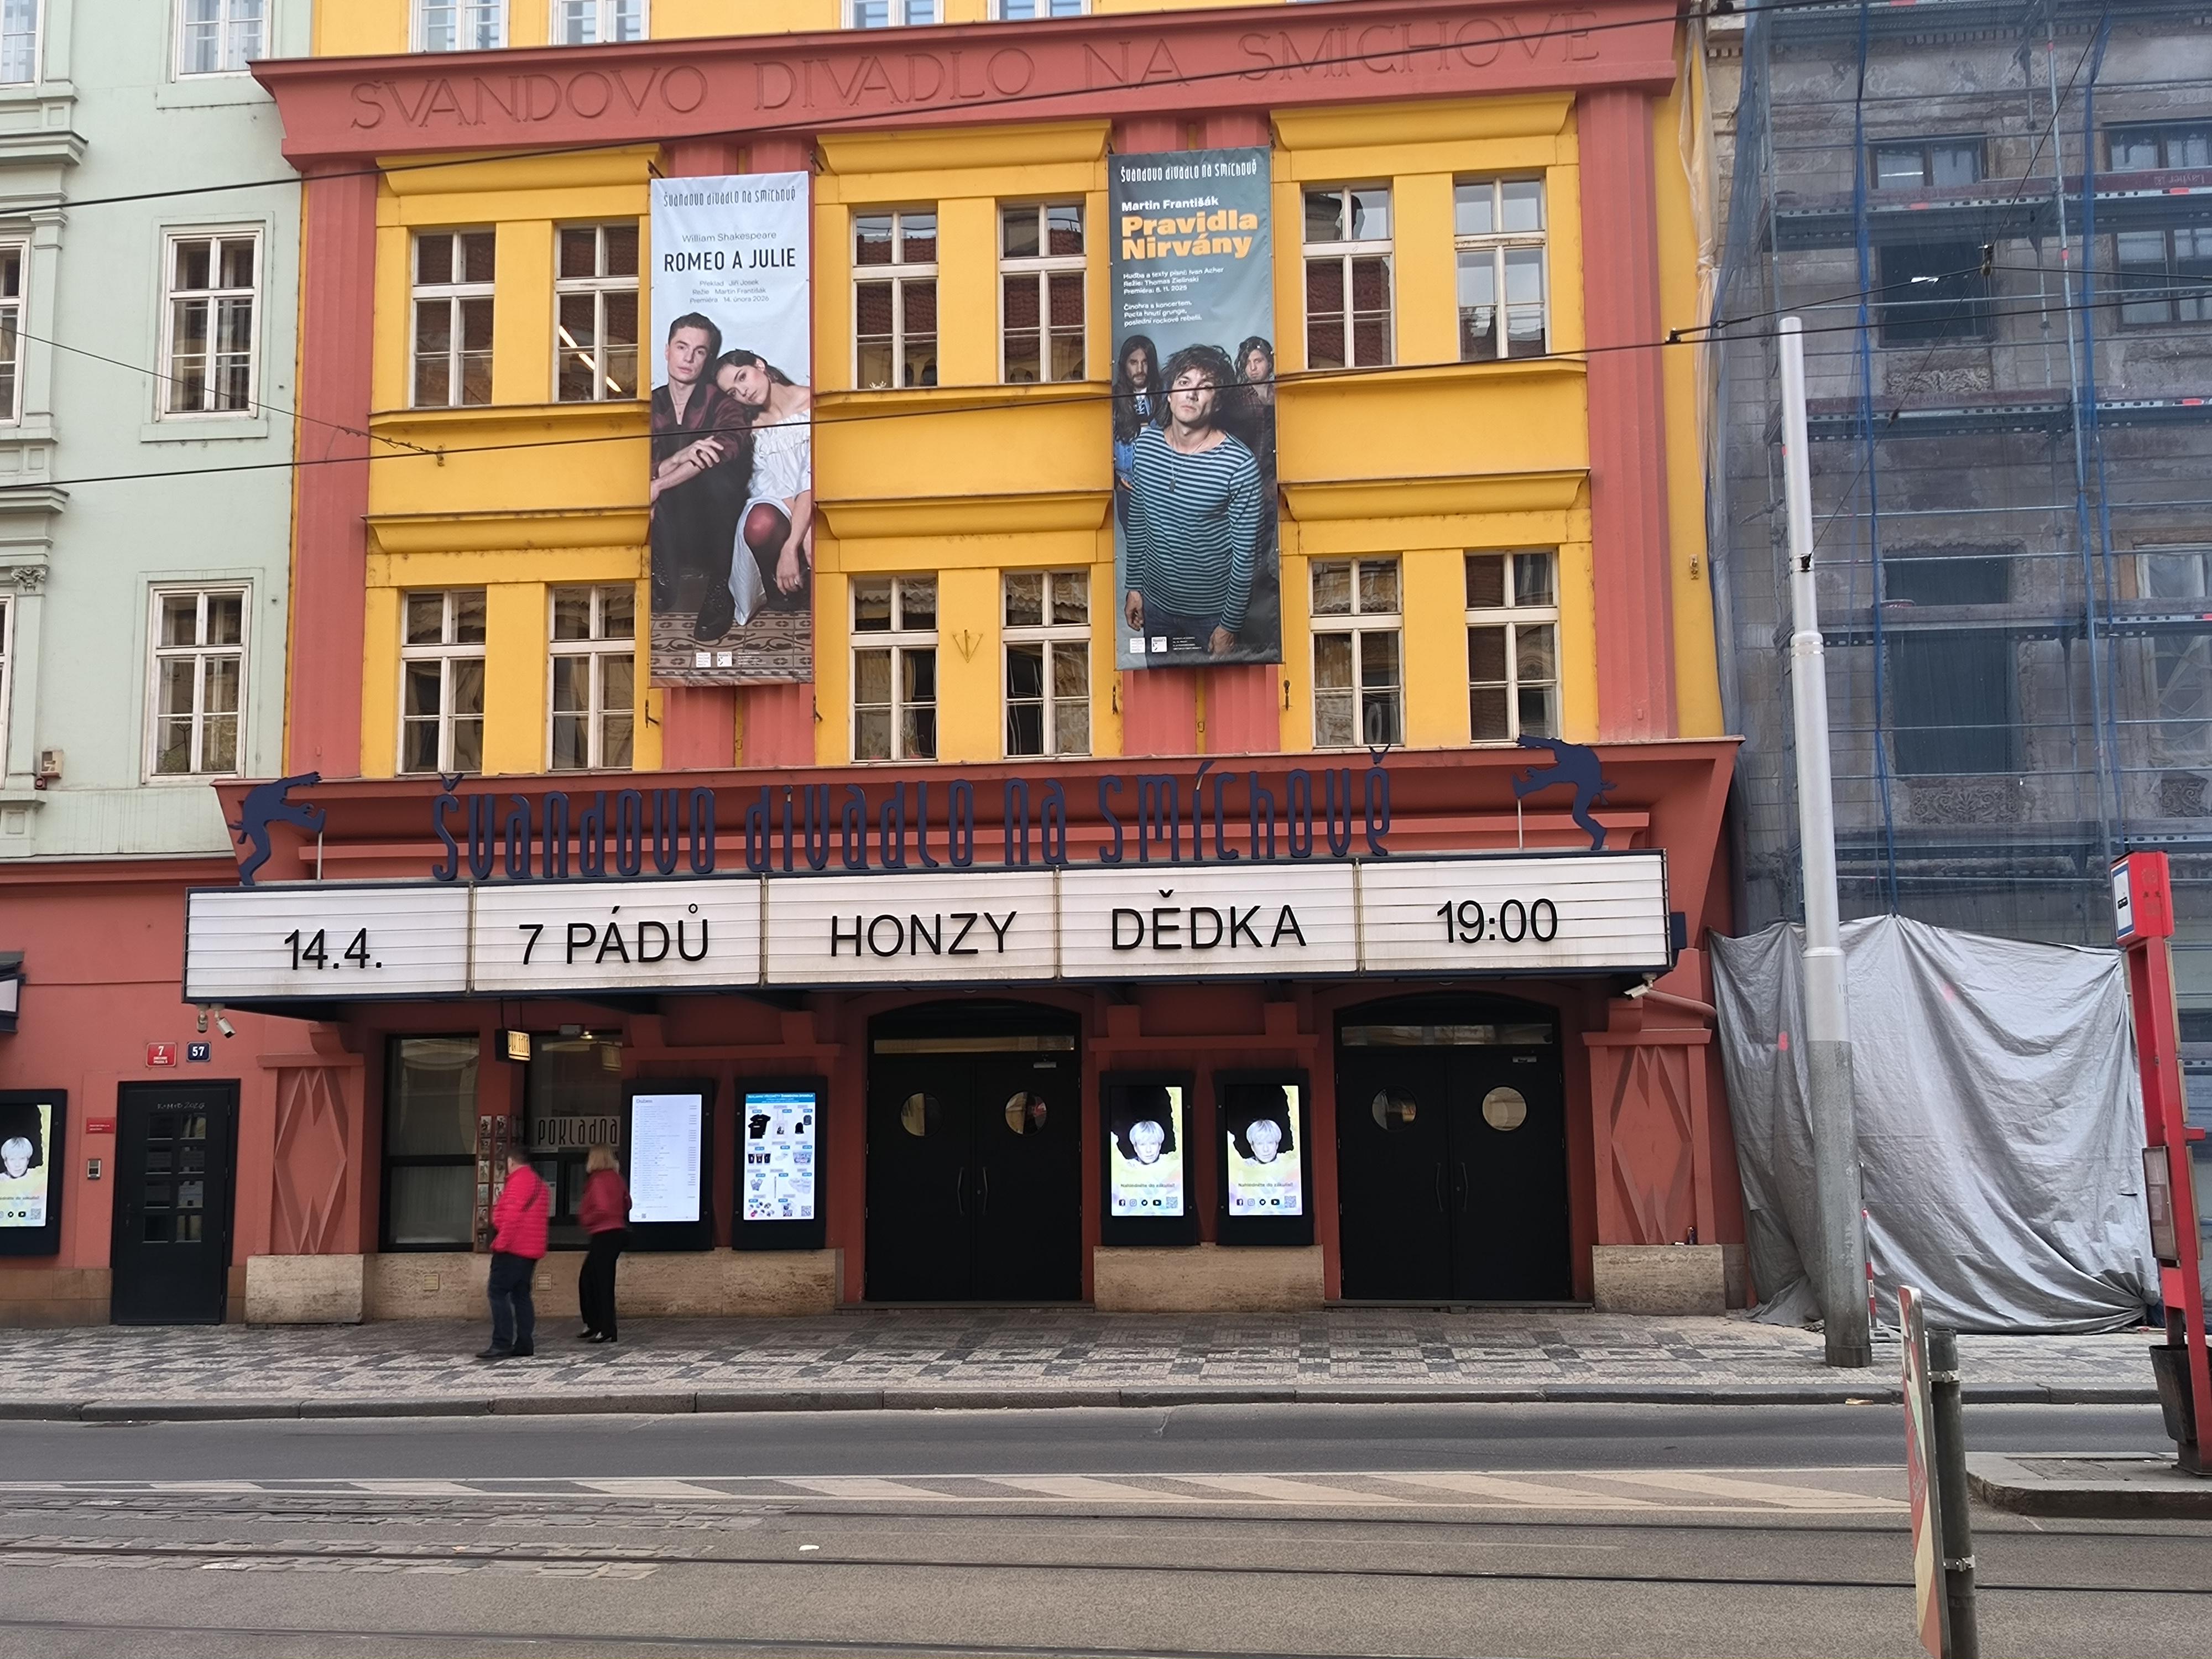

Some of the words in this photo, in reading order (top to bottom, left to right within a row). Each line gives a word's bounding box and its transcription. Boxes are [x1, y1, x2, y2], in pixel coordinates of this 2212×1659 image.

[351, 65, 708, 129] ŠVANDOVO
[753, 48, 1036, 111] DIVADLO
[1083, 38, 1191, 90] NA
[1165, 165, 1198, 180] divadlo
[1202, 163, 1212, 178] na
[707, 191, 739, 205] divadlo
[742, 190, 752, 204] na
[1121, 201, 1160, 211] Martin
[1163, 196, 1219, 209] Františák
[1121, 210, 1258, 237] Pravidla
[682, 234, 715, 243] William
[717, 232, 776, 242] Shakespeare
[1122, 232, 1253, 260] Nirvány
[664, 251, 724, 272] ROMEO
[732, 251, 743, 269] A
[749, 248, 796, 269] JULIE
[1124, 318, 1151, 327] poslední
[1152, 315, 1179, 324] rockové
[432, 773, 716, 880] Švandovo
[745, 779, 973, 874] divadlo
[1004, 778, 1067, 865] na
[284, 927, 382, 971] 14.4.
[518, 924, 544, 965] 7
[566, 902, 709, 964] PÁDŮ
[831, 911, 1018, 958] HONZY
[1111, 889, 1307, 951] DĚDKA
[1437, 898, 1558, 943] 19:00
[158, 1046, 164, 1056] 7
[192, 1046, 205, 1057] 57
